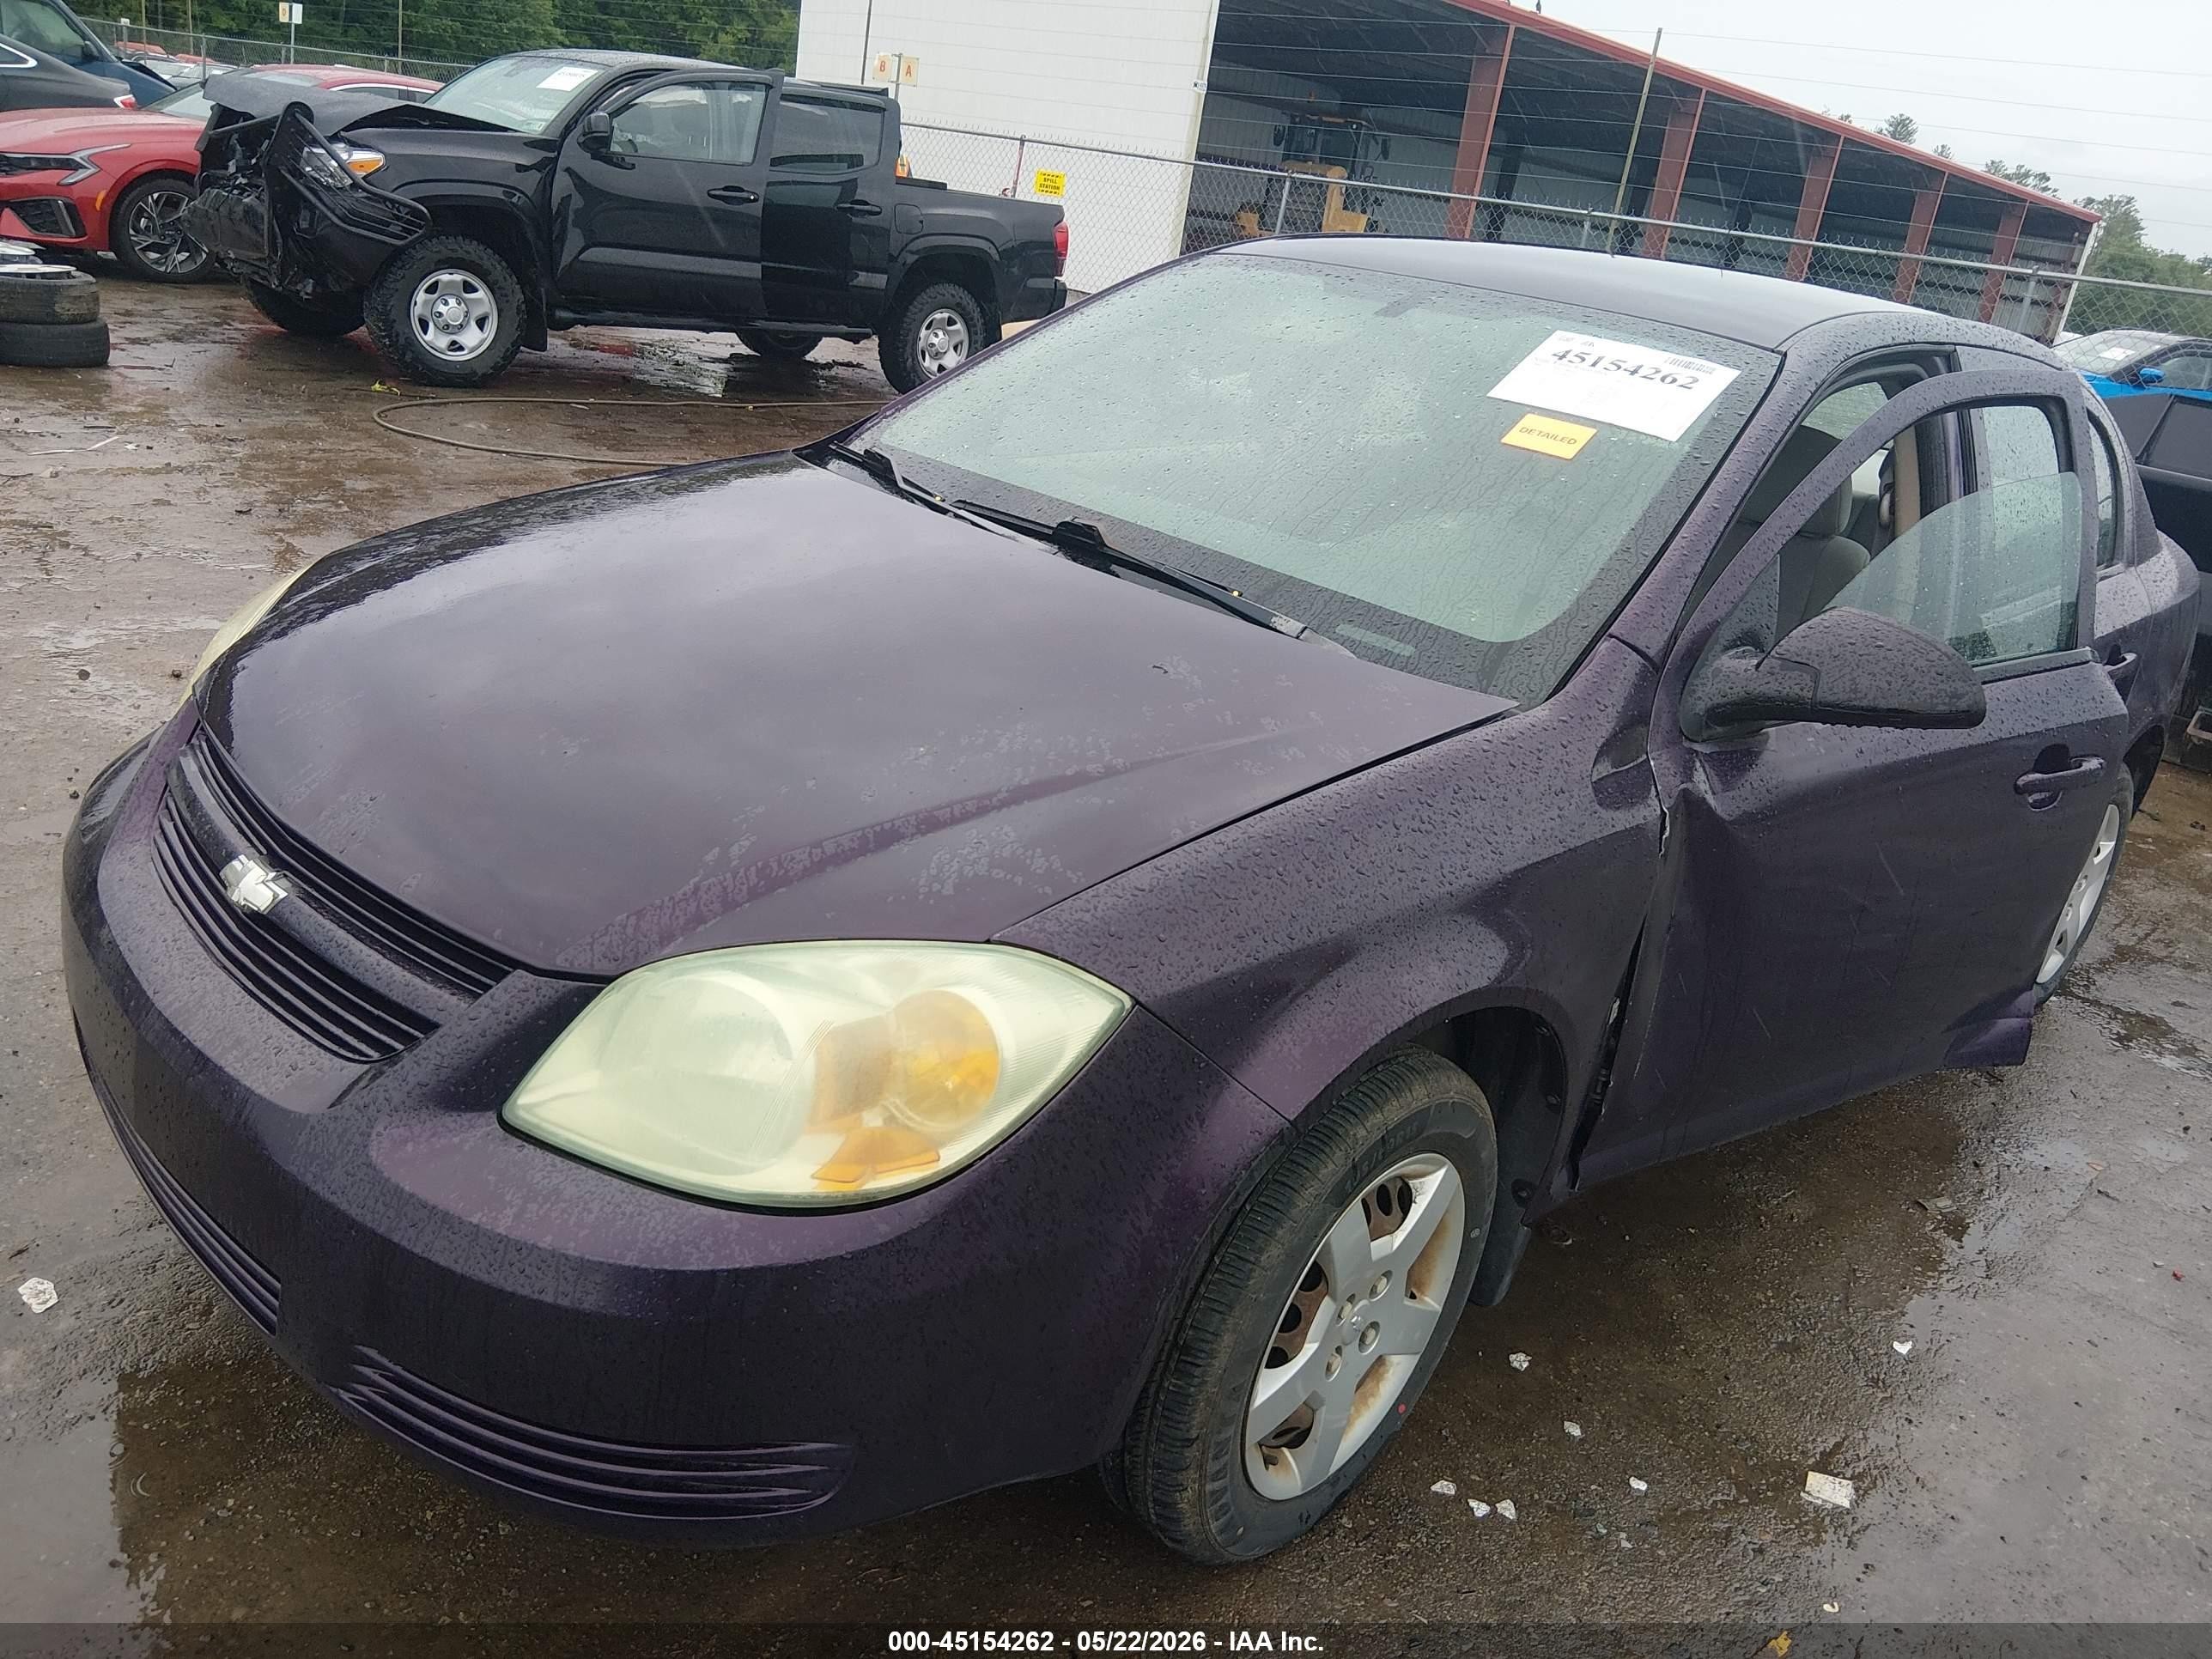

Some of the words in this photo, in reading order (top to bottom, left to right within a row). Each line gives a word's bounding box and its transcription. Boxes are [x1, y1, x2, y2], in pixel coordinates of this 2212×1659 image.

[879, 60, 885, 72] B
[905, 64, 912, 76] A
[1552, 349, 1699, 389] 45154262
[1519, 426, 1577, 445] DETAILED
